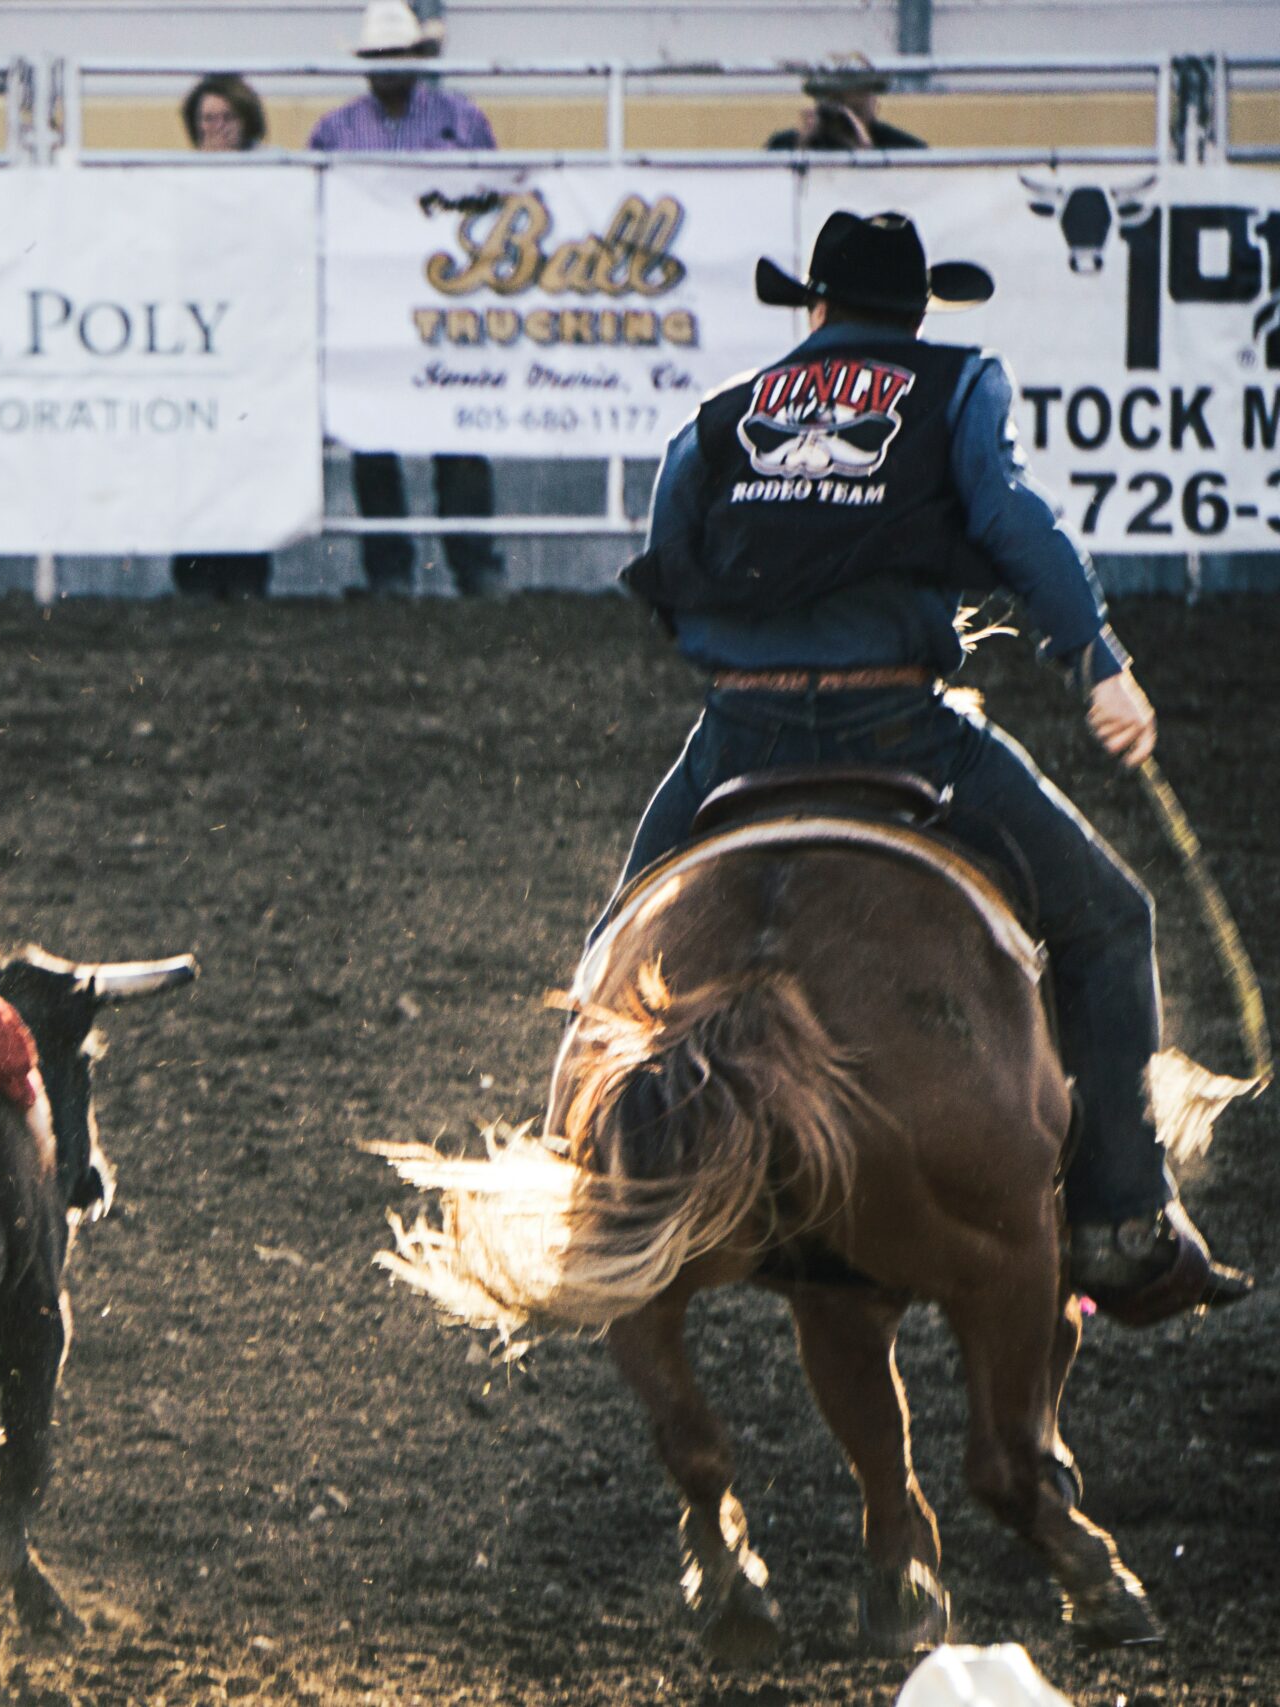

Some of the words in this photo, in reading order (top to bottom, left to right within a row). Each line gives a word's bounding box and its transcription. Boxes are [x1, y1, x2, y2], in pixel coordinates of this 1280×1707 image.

[425, 189, 687, 296] Ball
[24, 288, 232, 358] POLY
[412, 308, 699, 348] TRUCKING
[753, 359, 910, 418] UNLV
[1022, 386, 1215, 450] TOCK
[730, 479, 813, 503] RODEO
[816, 480, 887, 505] TEAM
